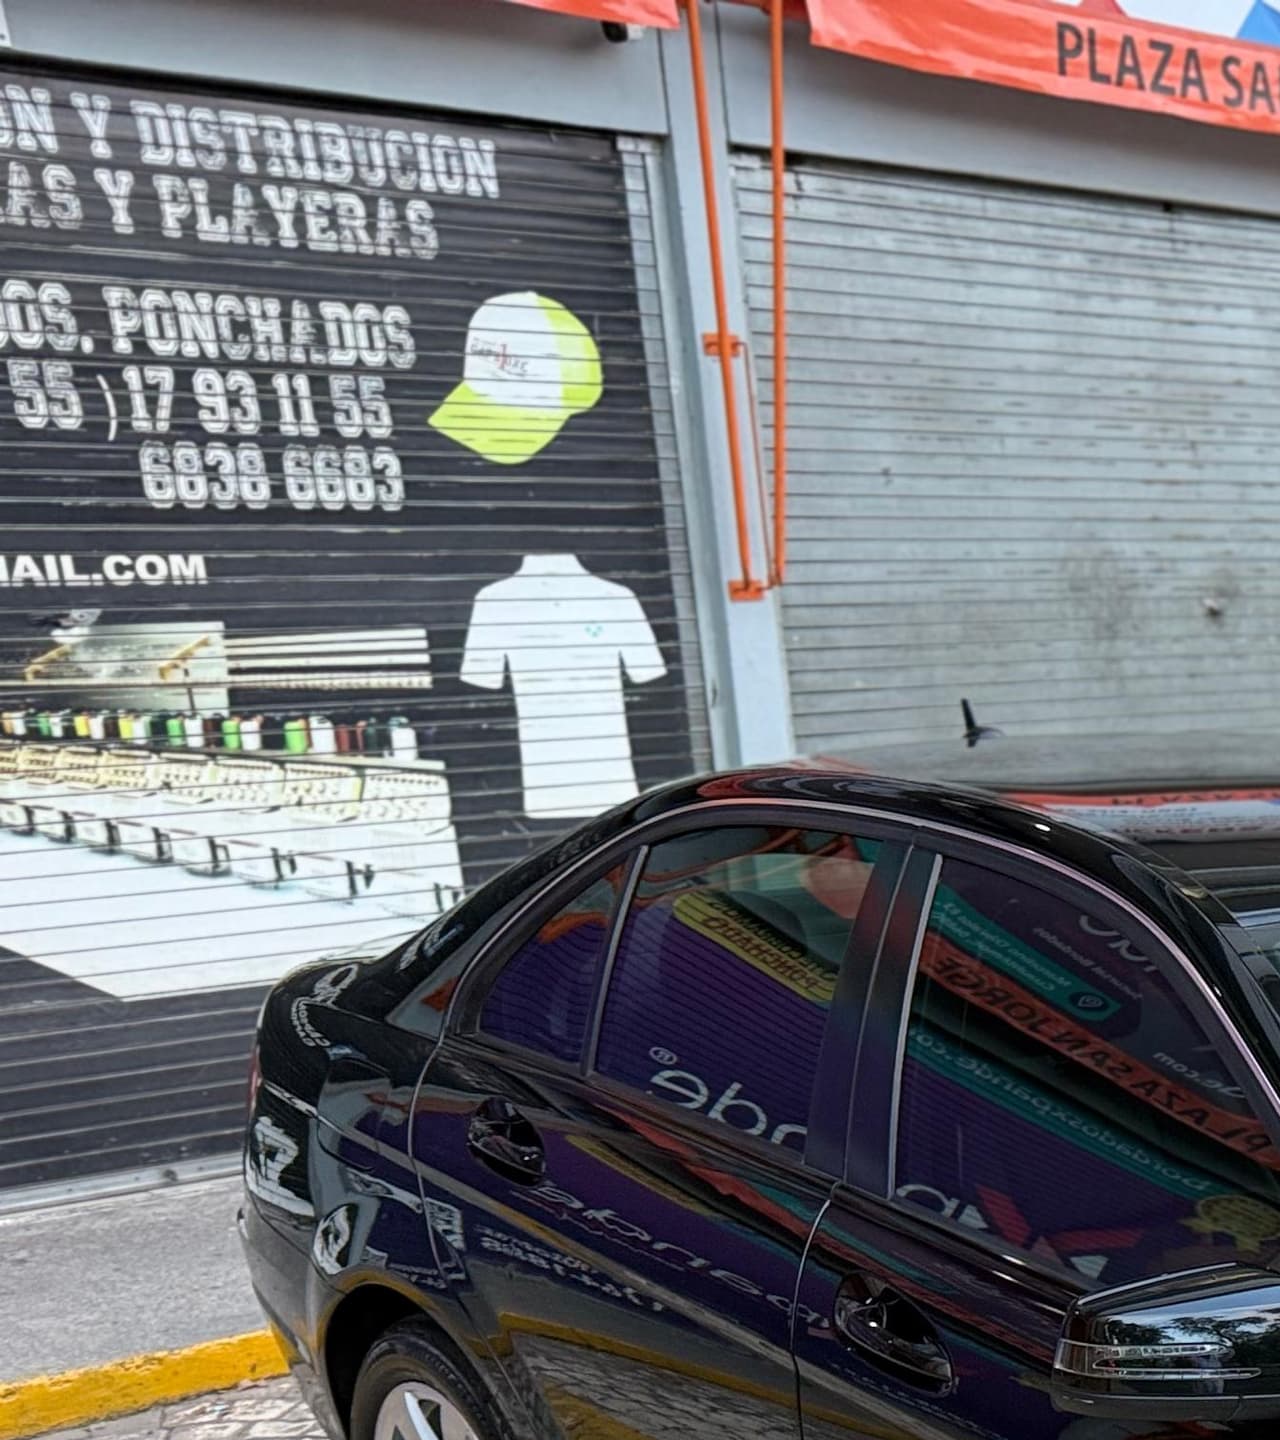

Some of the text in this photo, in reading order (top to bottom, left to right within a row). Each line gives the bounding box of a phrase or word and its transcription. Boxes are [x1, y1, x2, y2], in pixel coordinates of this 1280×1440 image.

[1055, 21, 1210, 106] PLAZA
[70, 91, 113, 160] Y
[129, 99, 500, 199] DISTRIBUCION
[0, 160, 440, 260] AS Y PLAYERAS
[0, 279, 95, 354] OS.
[101, 285, 417, 369] PONCHADOS
[192, 367, 262, 435] 93
[271, 372, 321, 438] 11
[328, 374, 394, 439] 55
